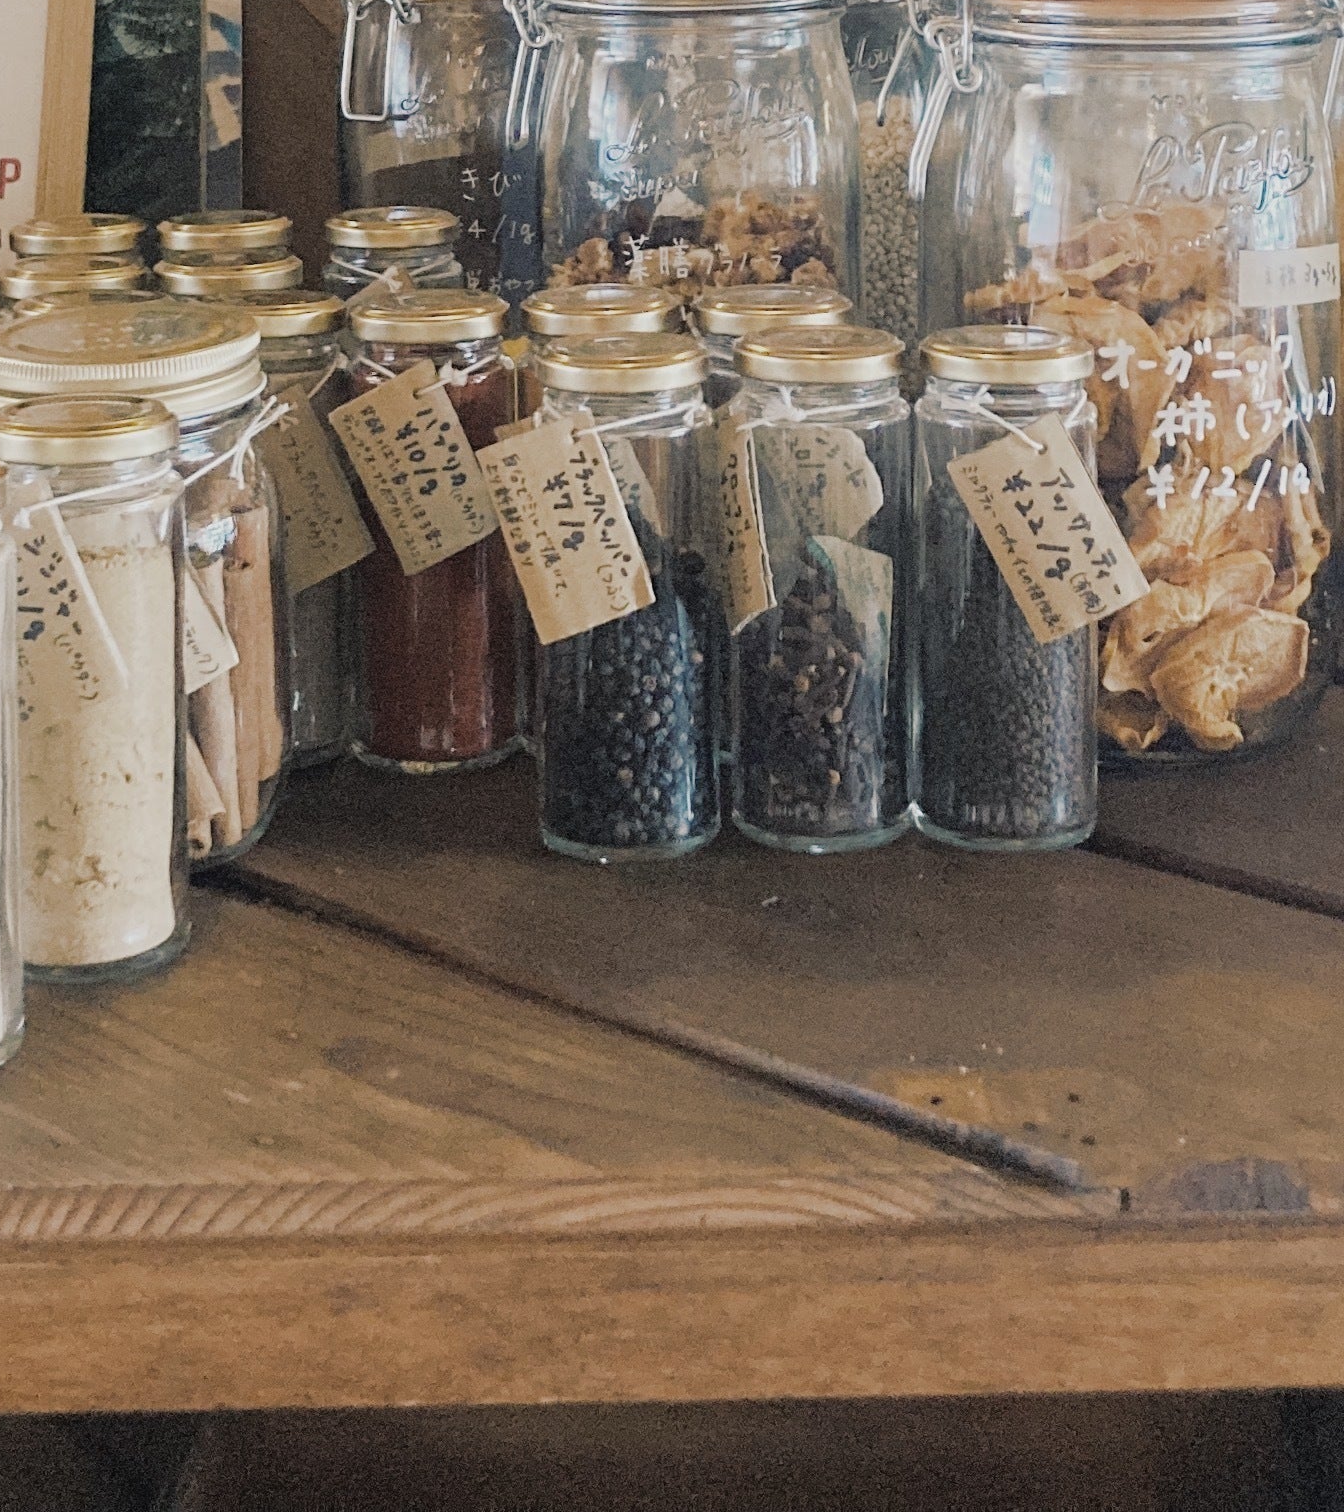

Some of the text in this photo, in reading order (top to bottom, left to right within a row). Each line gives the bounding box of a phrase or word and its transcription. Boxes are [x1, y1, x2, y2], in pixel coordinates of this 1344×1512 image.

[1097, 335, 1295, 390] オーガニック
[395, 420, 439, 496] ¥10/g
[415, 407, 467, 487] パプリカ
[1152, 392, 1217, 446] 柿
[543, 471, 586, 552] ¥7/g
[568, 450, 632, 577] ブラックペッパー
[1002, 469, 1072, 581] ¥22/g
[1039, 467, 1122, 595] アッサムティー
